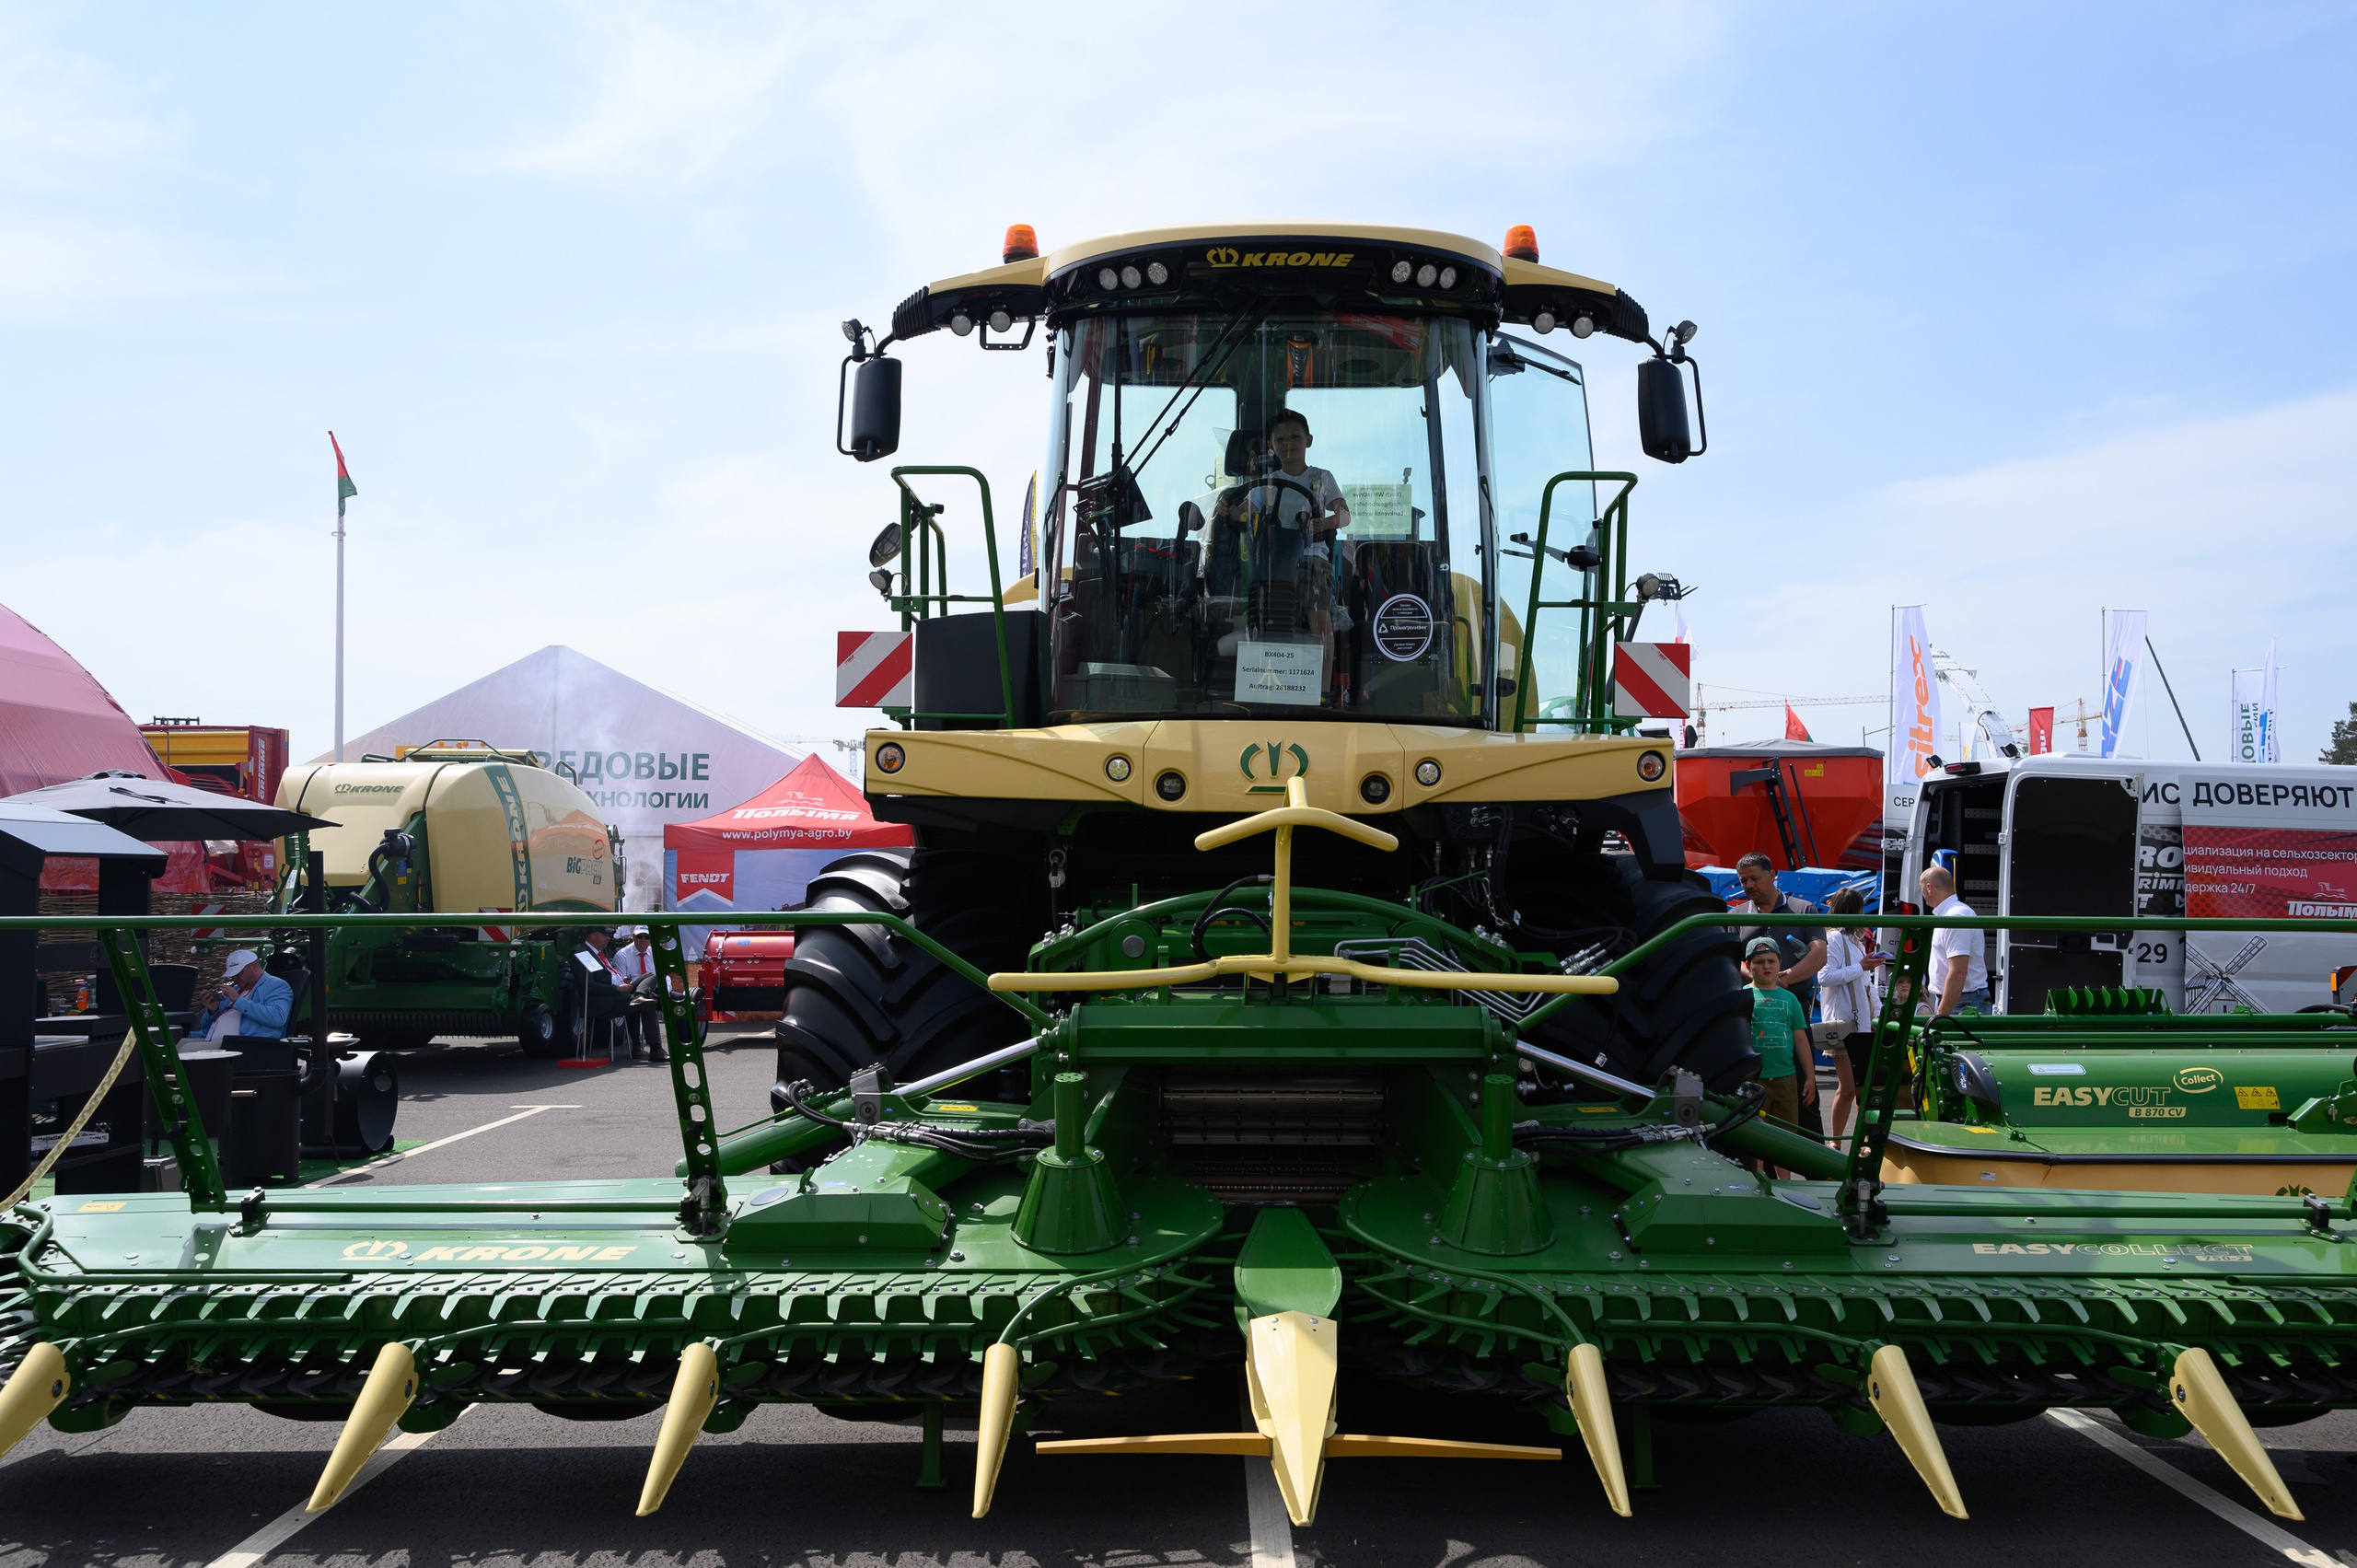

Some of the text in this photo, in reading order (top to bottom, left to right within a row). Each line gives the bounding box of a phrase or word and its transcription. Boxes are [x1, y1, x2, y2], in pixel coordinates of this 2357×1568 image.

[1241, 251, 1355, 267] KRONE
[1242, 666, 1287, 675] Serialnummer:
[1248, 682, 1275, 691] Auftrag:
[350, 784, 404, 794] KRONE
[2192, 782, 2354, 808] ДОВЕРЯЮТ
[496, 775, 528, 885] KRONE
[722, 829, 853, 841] www.polymya-agro.by
[2256, 848, 2270, 857] на
[680, 873, 730, 883] FENDT
[2264, 866, 2308, 878] подход
[2230, 883, 2256, 894] 24/7
[2137, 943, 2167, 964] 29
[2180, 1074, 2216, 1086] Collect
[2033, 1086, 2171, 1106] EASYCUT
[2134, 1108, 2184, 1117] B 870 CV
[412, 1245, 639, 1261] KRONE
